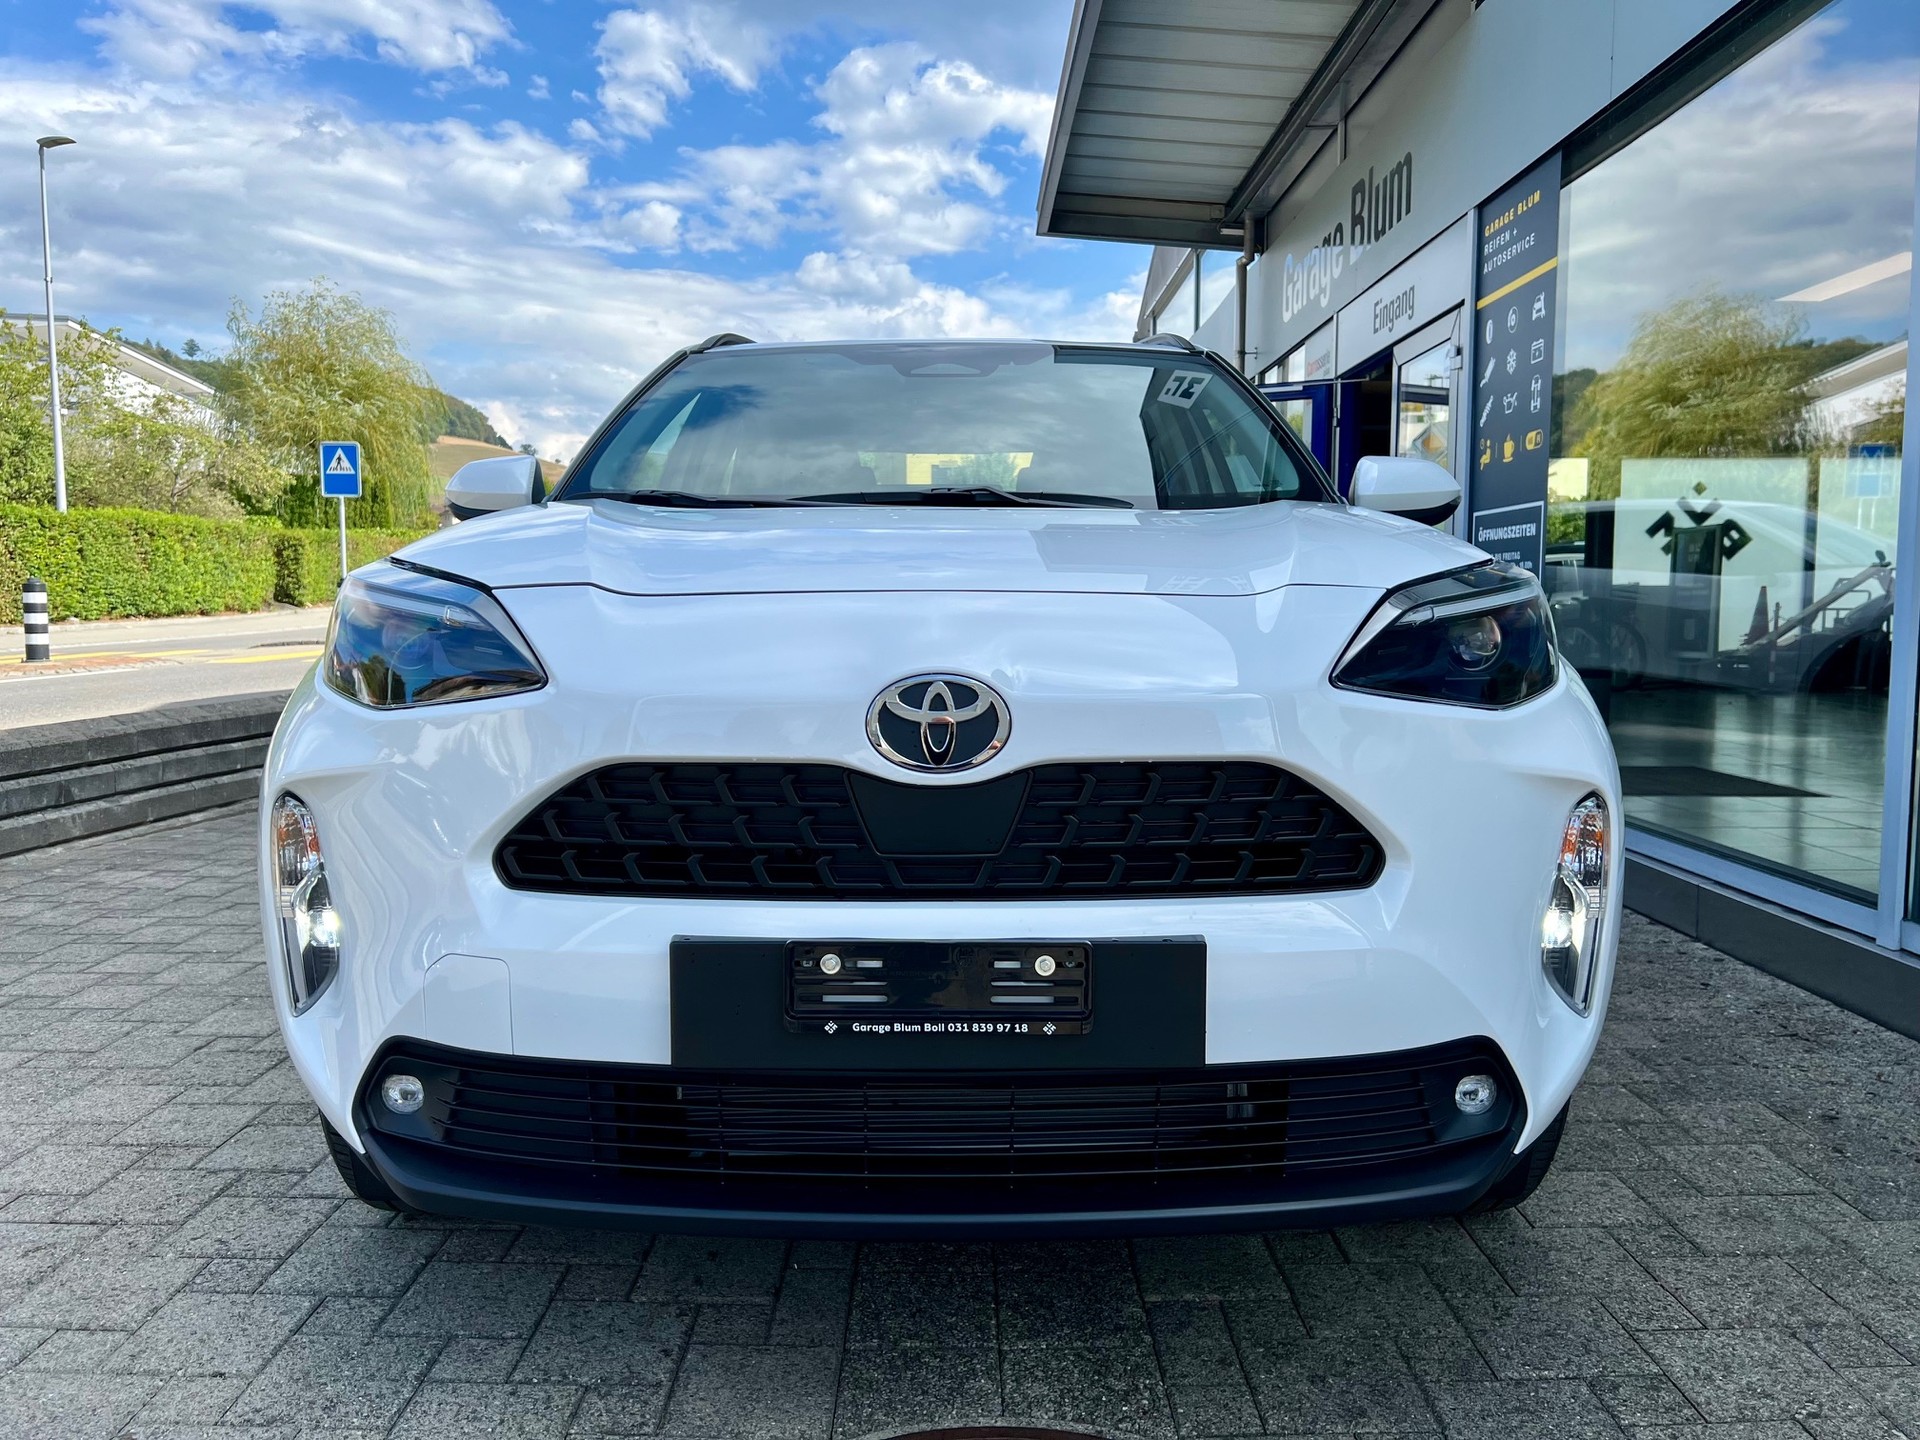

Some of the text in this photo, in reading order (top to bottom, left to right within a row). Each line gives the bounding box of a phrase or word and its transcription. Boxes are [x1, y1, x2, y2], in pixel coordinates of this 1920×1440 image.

[1484, 190, 1541, 237] GARAGE BLUM
[1283, 152, 1412, 322] Garage Blum
[1483, 233, 1535, 275] AUTOSERVICE
[1484, 231, 1510, 256] REIFEN
[1373, 285, 1415, 334] Eingang
[1478, 522, 1537, 542] ÖFFNUNGSZEITEN
[852, 1022, 1029, 1034] Garage Blum Boll 031 839 97 18
